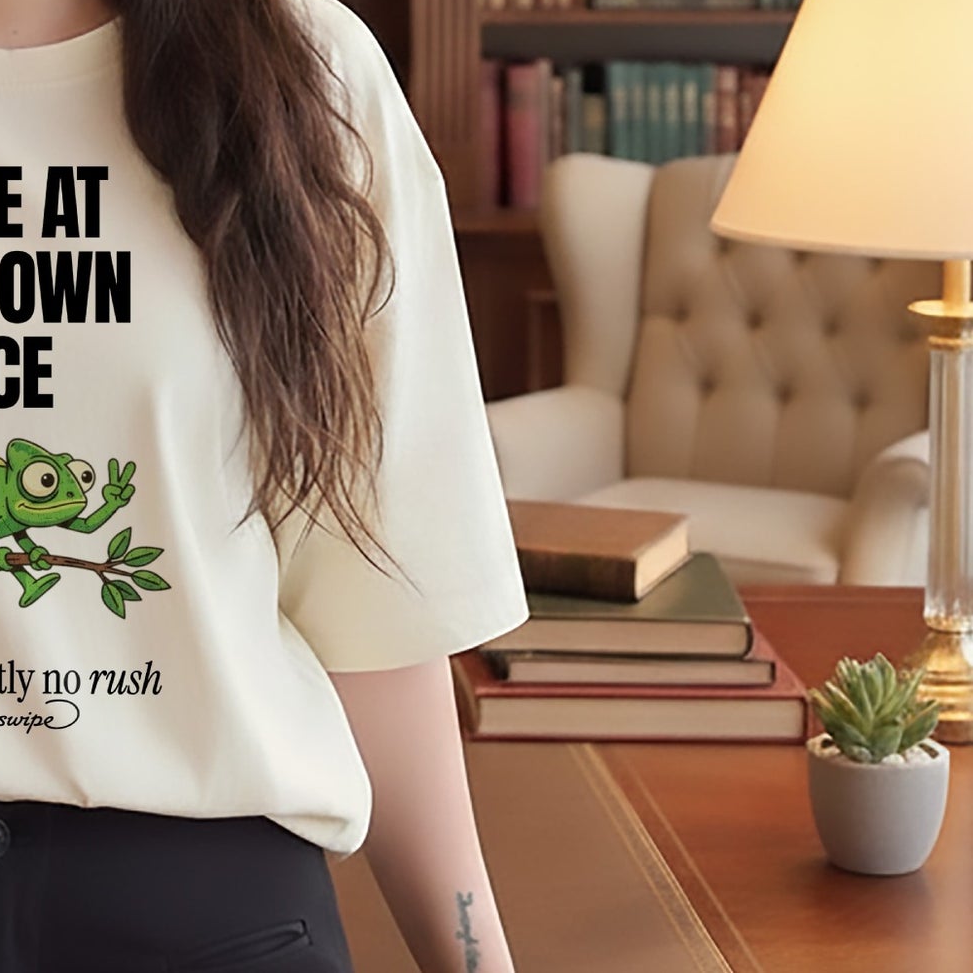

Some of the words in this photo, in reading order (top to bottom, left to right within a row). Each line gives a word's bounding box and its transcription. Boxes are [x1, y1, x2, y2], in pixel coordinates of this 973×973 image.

[41, 165, 109, 239] AT
[0, 250, 132, 324] OWN
[42, 669, 81, 695] no
[89, 660, 163, 695] rush
